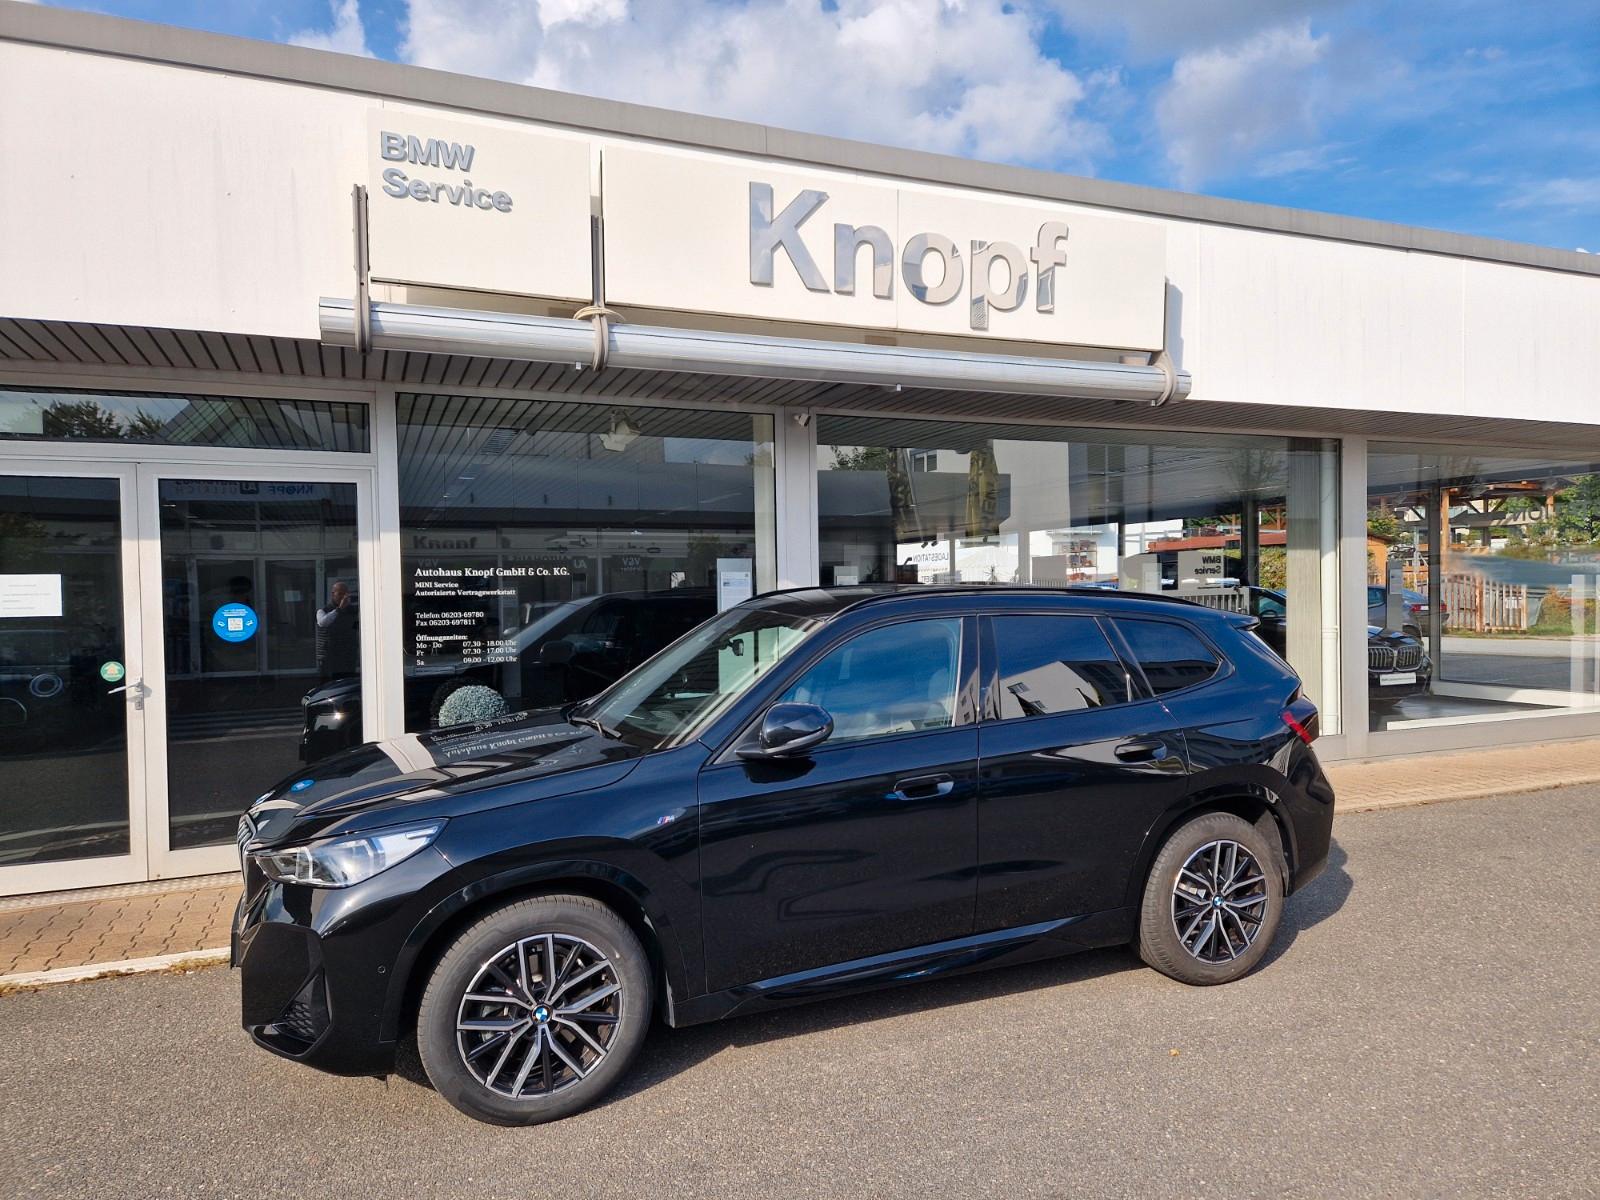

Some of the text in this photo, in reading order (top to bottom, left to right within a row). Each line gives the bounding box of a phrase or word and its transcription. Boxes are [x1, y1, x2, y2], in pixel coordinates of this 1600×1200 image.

[381, 130, 475, 172] BMW
[382, 168, 513, 213] Service
[749, 181, 1069, 331] Knopf
[414, 567, 570, 578] Autohaus Knopf GmbH & Co. KG.
[415, 589, 517, 597] Autorisierte Vertragswerkstatt
